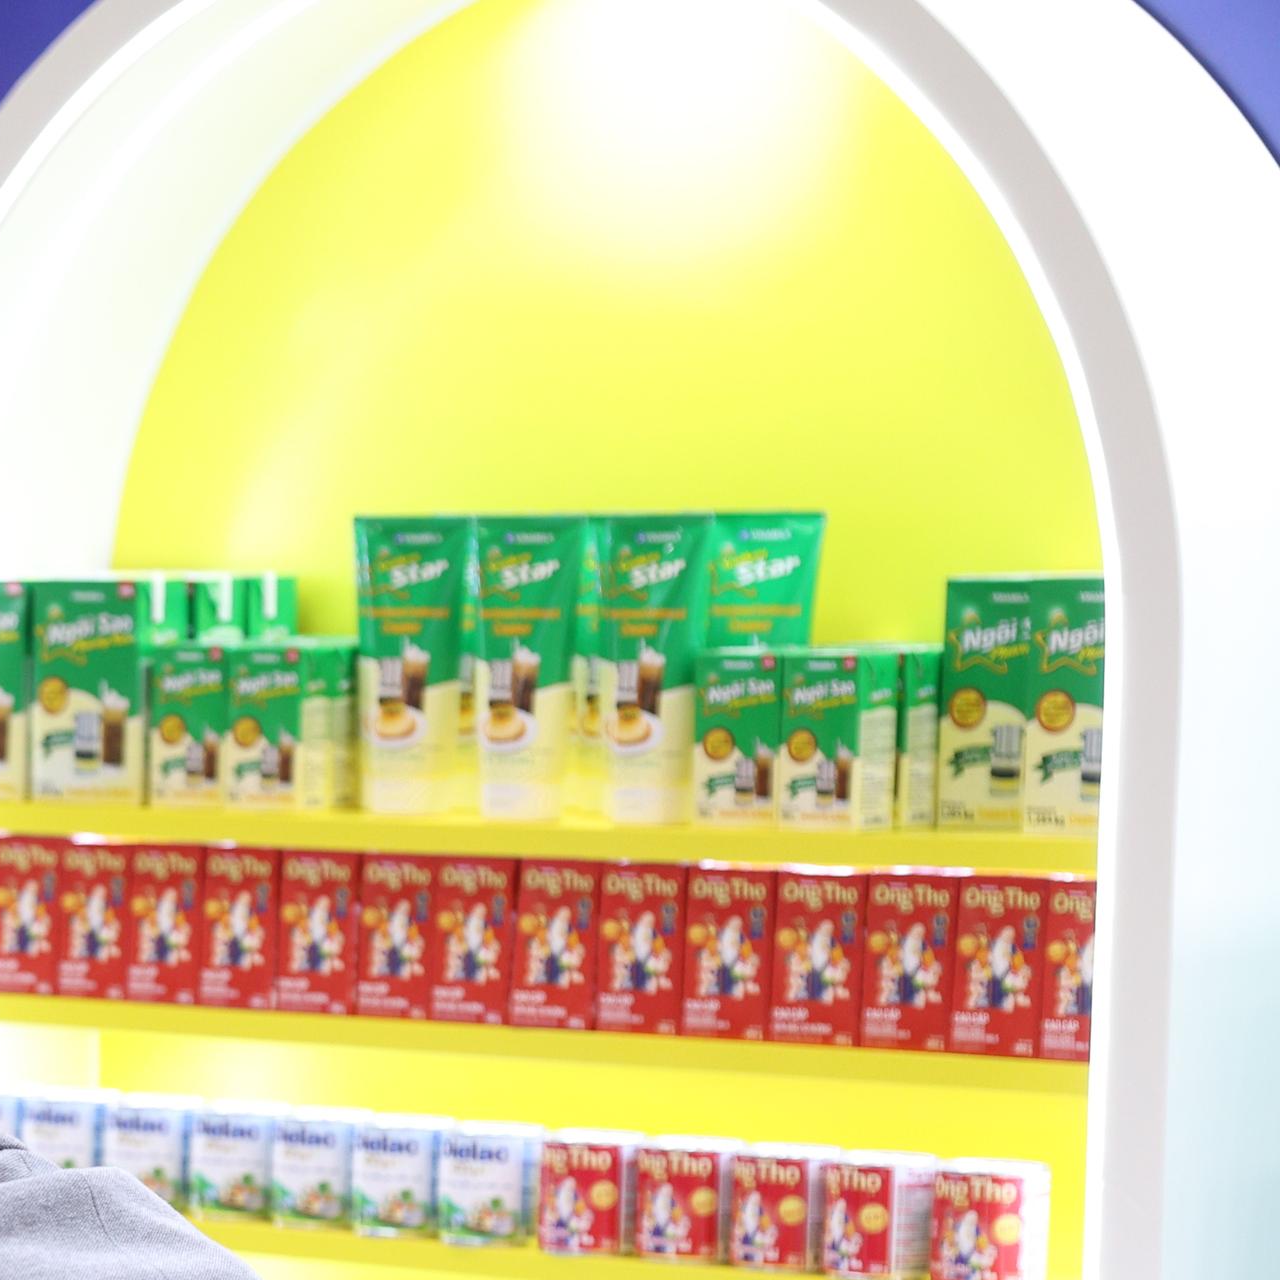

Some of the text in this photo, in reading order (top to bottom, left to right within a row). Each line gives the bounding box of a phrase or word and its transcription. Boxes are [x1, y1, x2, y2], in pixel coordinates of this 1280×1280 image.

[392, 558, 450, 589] Star
[501, 558, 560, 589] Star
[630, 557, 687, 588] Star
[734, 554, 802, 586] Star
